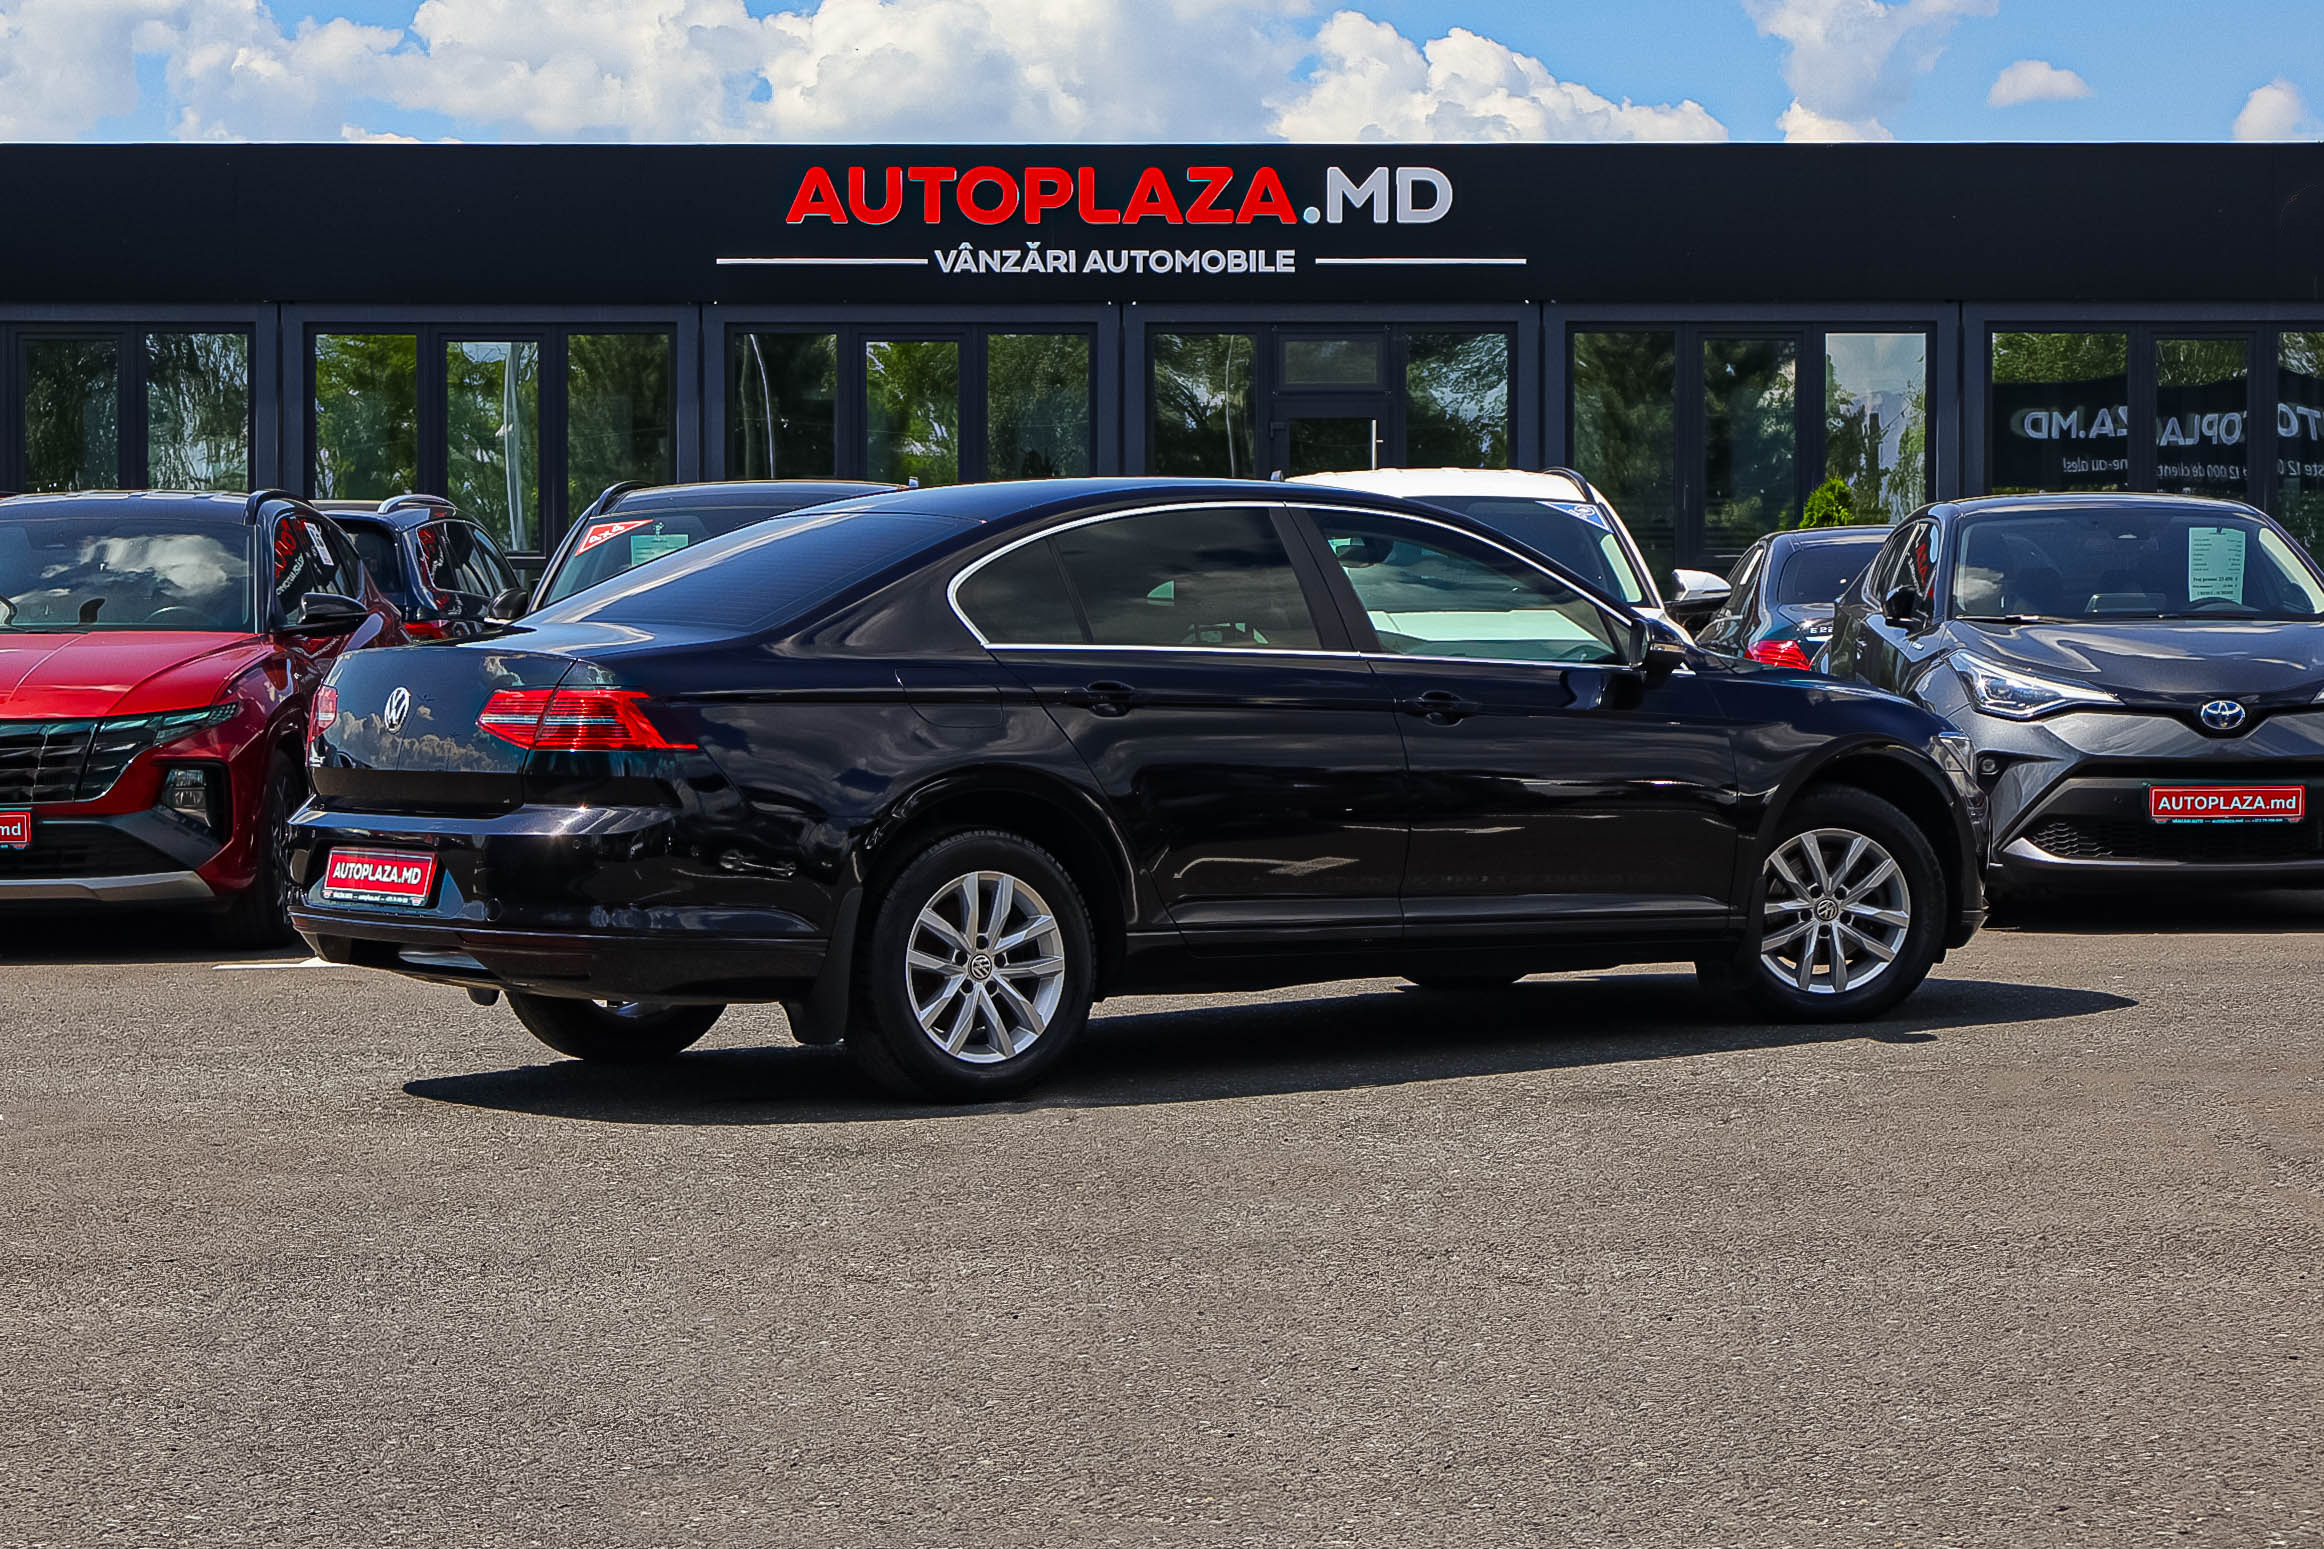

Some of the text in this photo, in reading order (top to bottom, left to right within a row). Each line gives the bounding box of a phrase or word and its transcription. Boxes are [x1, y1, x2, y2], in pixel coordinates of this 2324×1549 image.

[786, 166, 1453, 226] AUTOPLAZA.MD
[934, 242, 1296, 274] VÂNZĂRI AUTOMOBILE
[2158, 795, 2297, 811] AUTOPLAZA.md
[332, 861, 422, 885] AUTOPLAZA.MD
